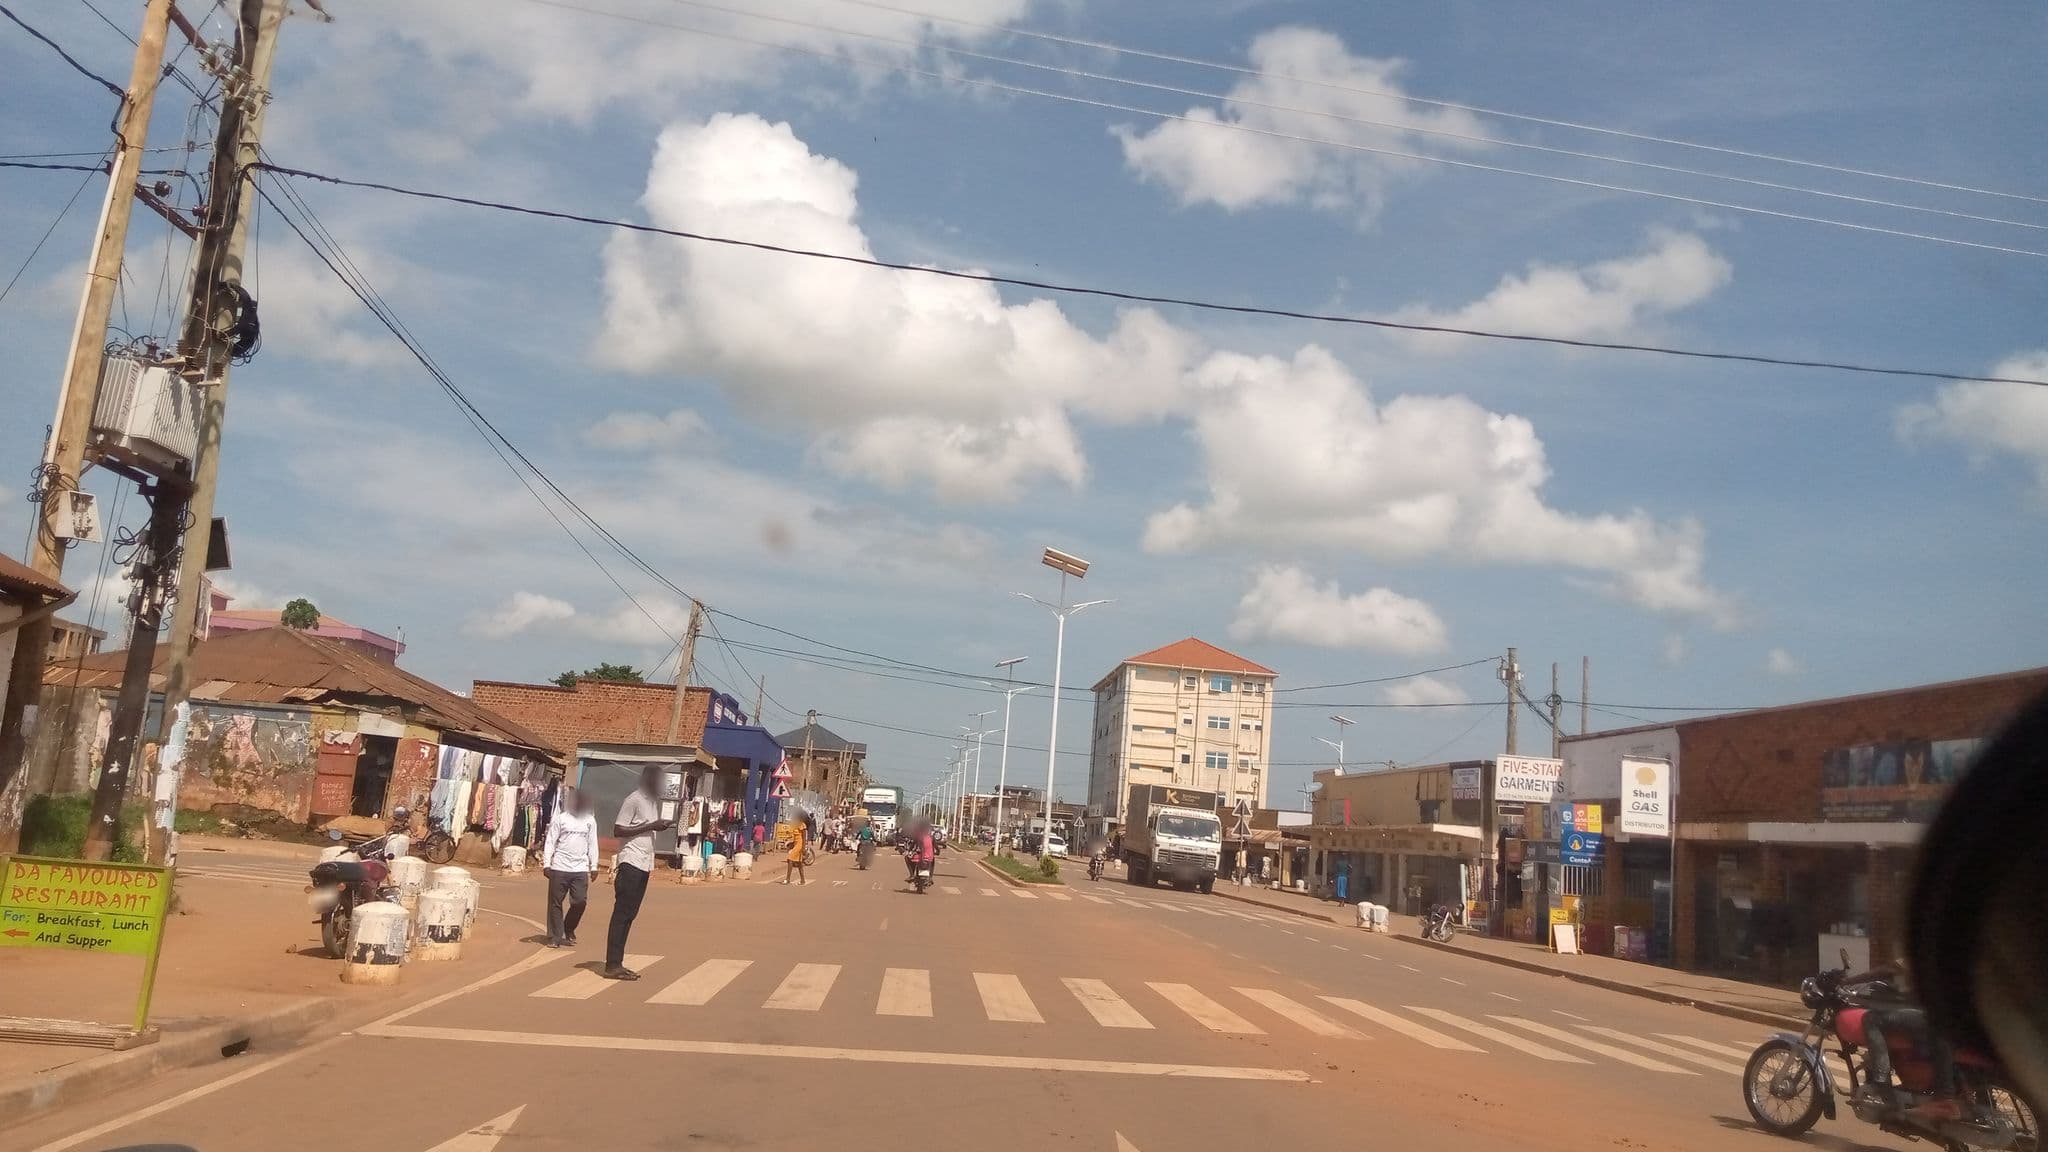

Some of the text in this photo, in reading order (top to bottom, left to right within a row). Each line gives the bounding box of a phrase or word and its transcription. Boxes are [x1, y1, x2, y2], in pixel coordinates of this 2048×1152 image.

[1503, 760, 1563, 777] FIVE-STAR
[1500, 776, 1565, 793] GARMENTS
[1633, 789, 1658, 799] Shell
[1632, 801, 1660, 813] GAS
[1624, 820, 1665, 830] DISTRIBUTOR
[15, 861, 158, 889] DA FAVOURED
[11, 885, 151, 912] RESTAURANT
[37, 913, 105, 930] Breakfast,
[112, 918, 149, 931] Lunch
[36, 931, 112, 949] And Supper
